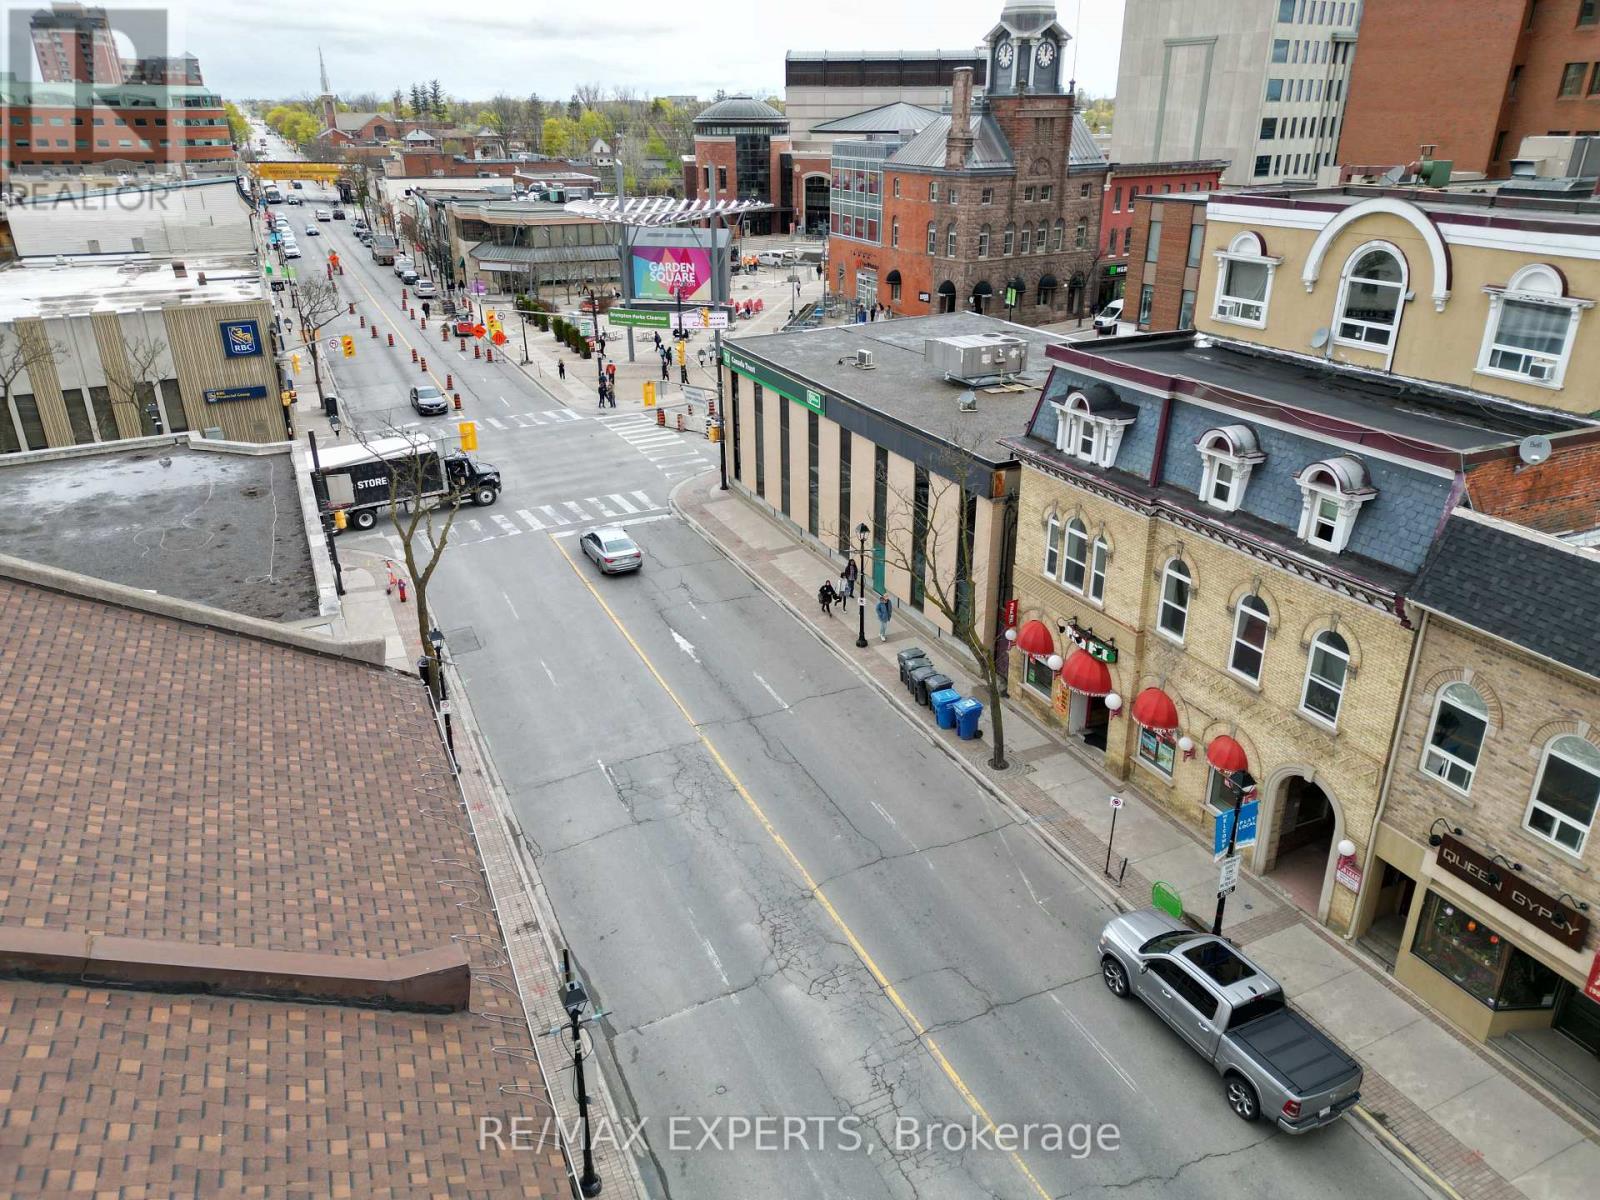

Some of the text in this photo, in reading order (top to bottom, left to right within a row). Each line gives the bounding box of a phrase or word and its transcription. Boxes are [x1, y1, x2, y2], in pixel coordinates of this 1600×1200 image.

[649, 262, 695, 273] GARDEN
[649, 272, 696, 283] SQUARE
[234, 344, 253, 352] RBC
[357, 476, 388, 490] STORE
[1239, 815, 1257, 826] PLAY
